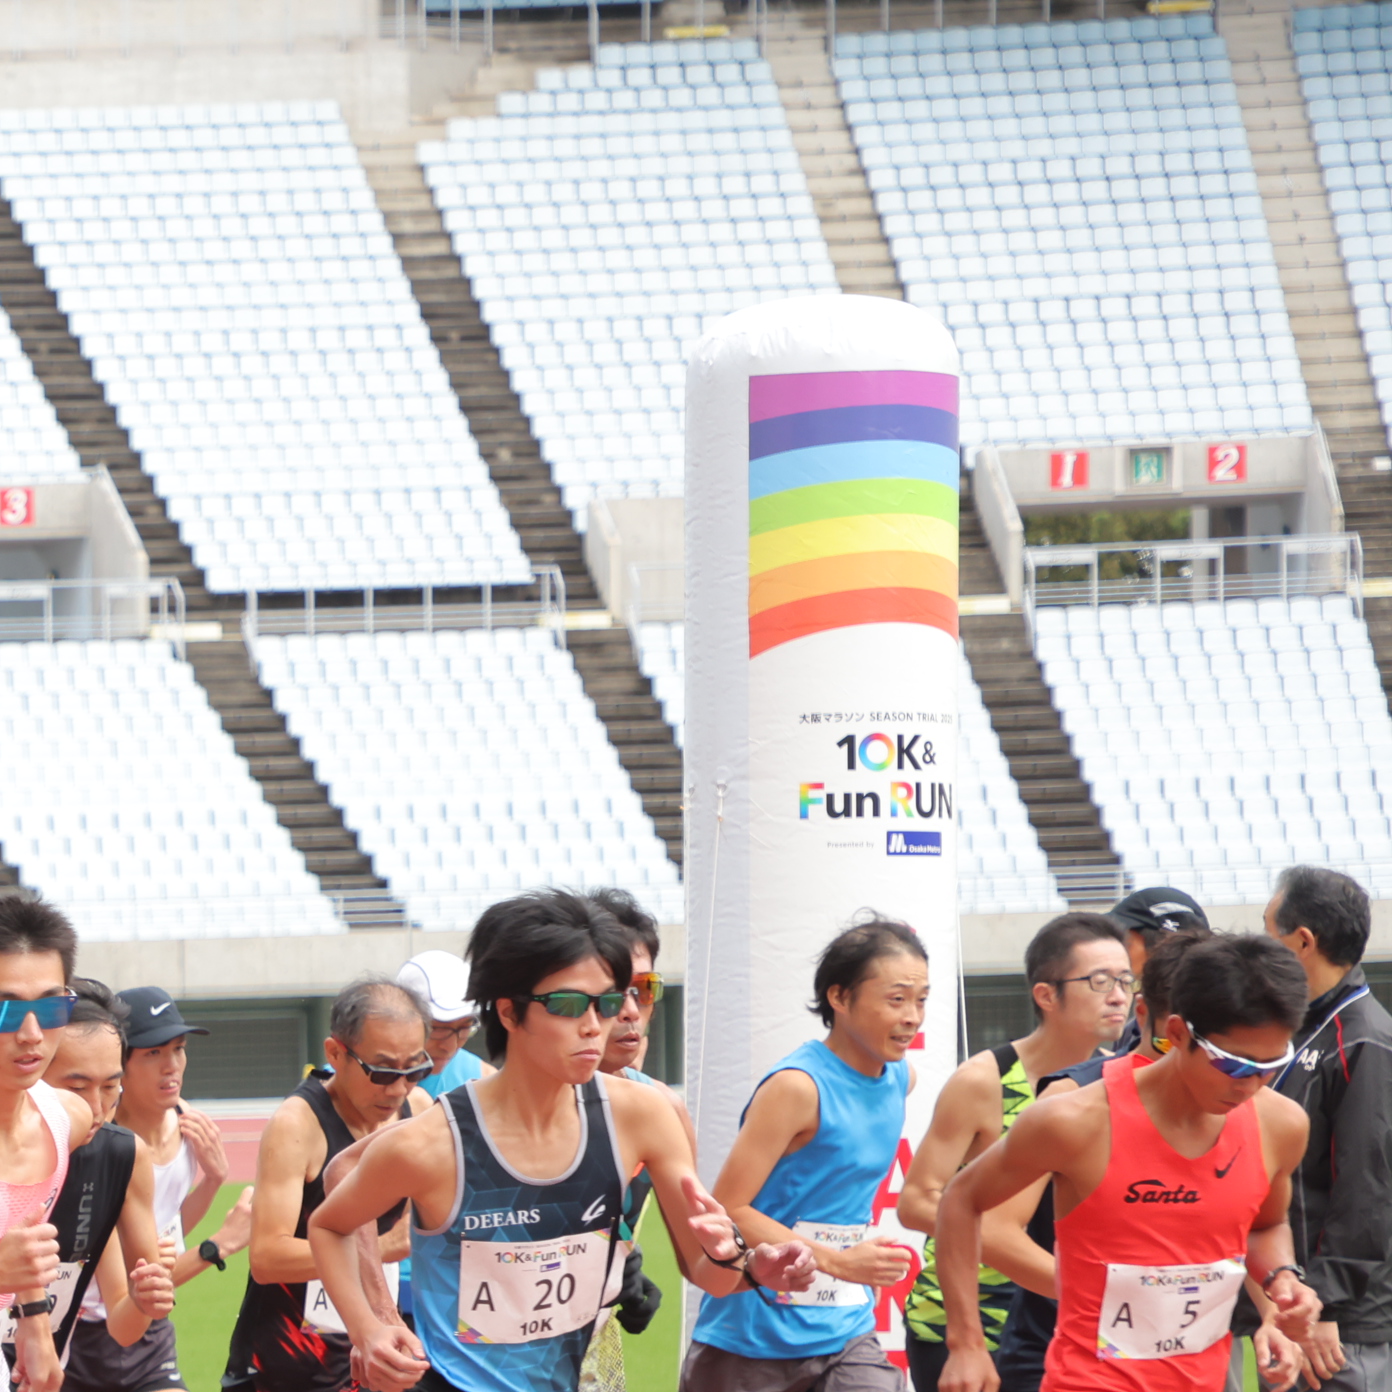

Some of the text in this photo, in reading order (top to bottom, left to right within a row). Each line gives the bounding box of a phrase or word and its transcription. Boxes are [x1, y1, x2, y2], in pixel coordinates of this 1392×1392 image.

[1214, 444, 1240, 482] 2
[1, 488, 28, 525] 3
[799, 712, 864, 724] 大阪マラソン
[870, 711, 913, 722] SEASON
[917, 712, 938, 723] TRIAL
[799, 781, 952, 819] Fun RUN
[1124, 1179, 1200, 1203] Santa
[464, 1209, 541, 1230] DEEARS
[313, 1288, 328, 1311] A
[471, 1273, 576, 1312] A 20
[816, 1290, 836, 1301] 10K
[1111, 1300, 1200, 1329] A 5
[520, 1317, 553, 1336] 10K
[1154, 1337, 1185, 1352] 10K
